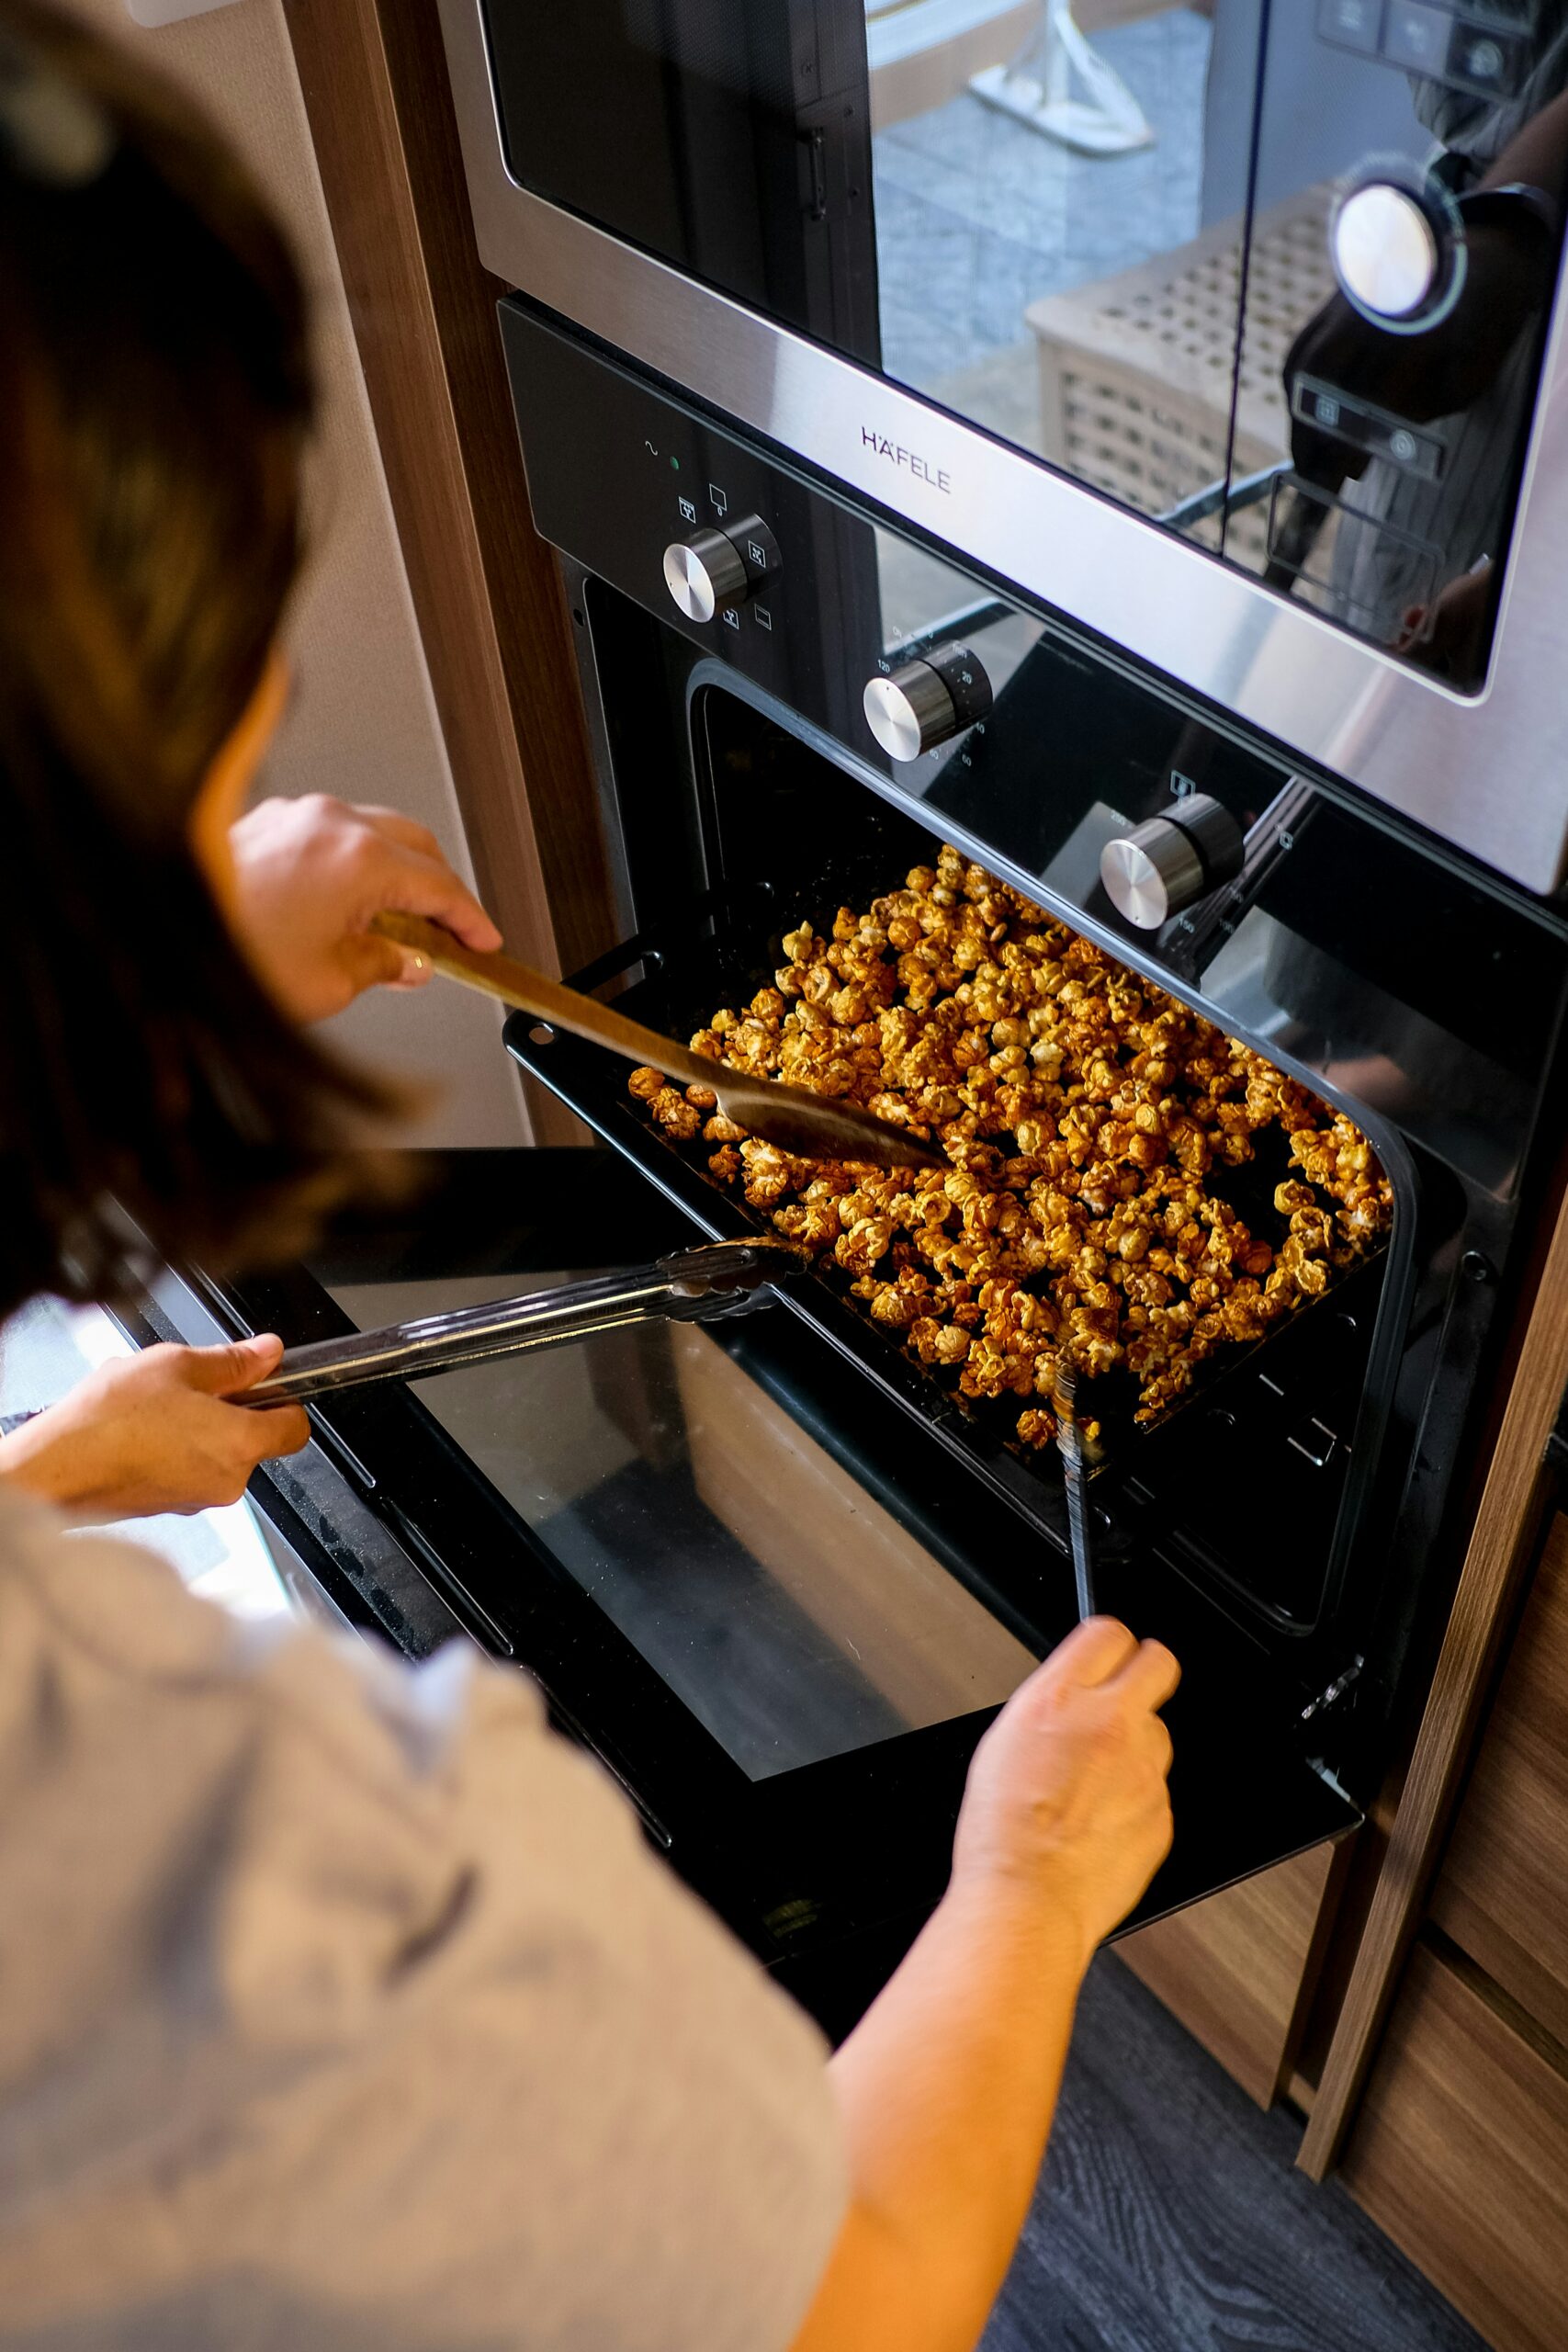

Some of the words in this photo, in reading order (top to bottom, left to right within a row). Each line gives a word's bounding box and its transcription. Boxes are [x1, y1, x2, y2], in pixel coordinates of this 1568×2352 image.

[862, 425, 952, 494] HÄFELE
[877, 659, 890, 673] 120
[962, 671, 973, 684] 20
